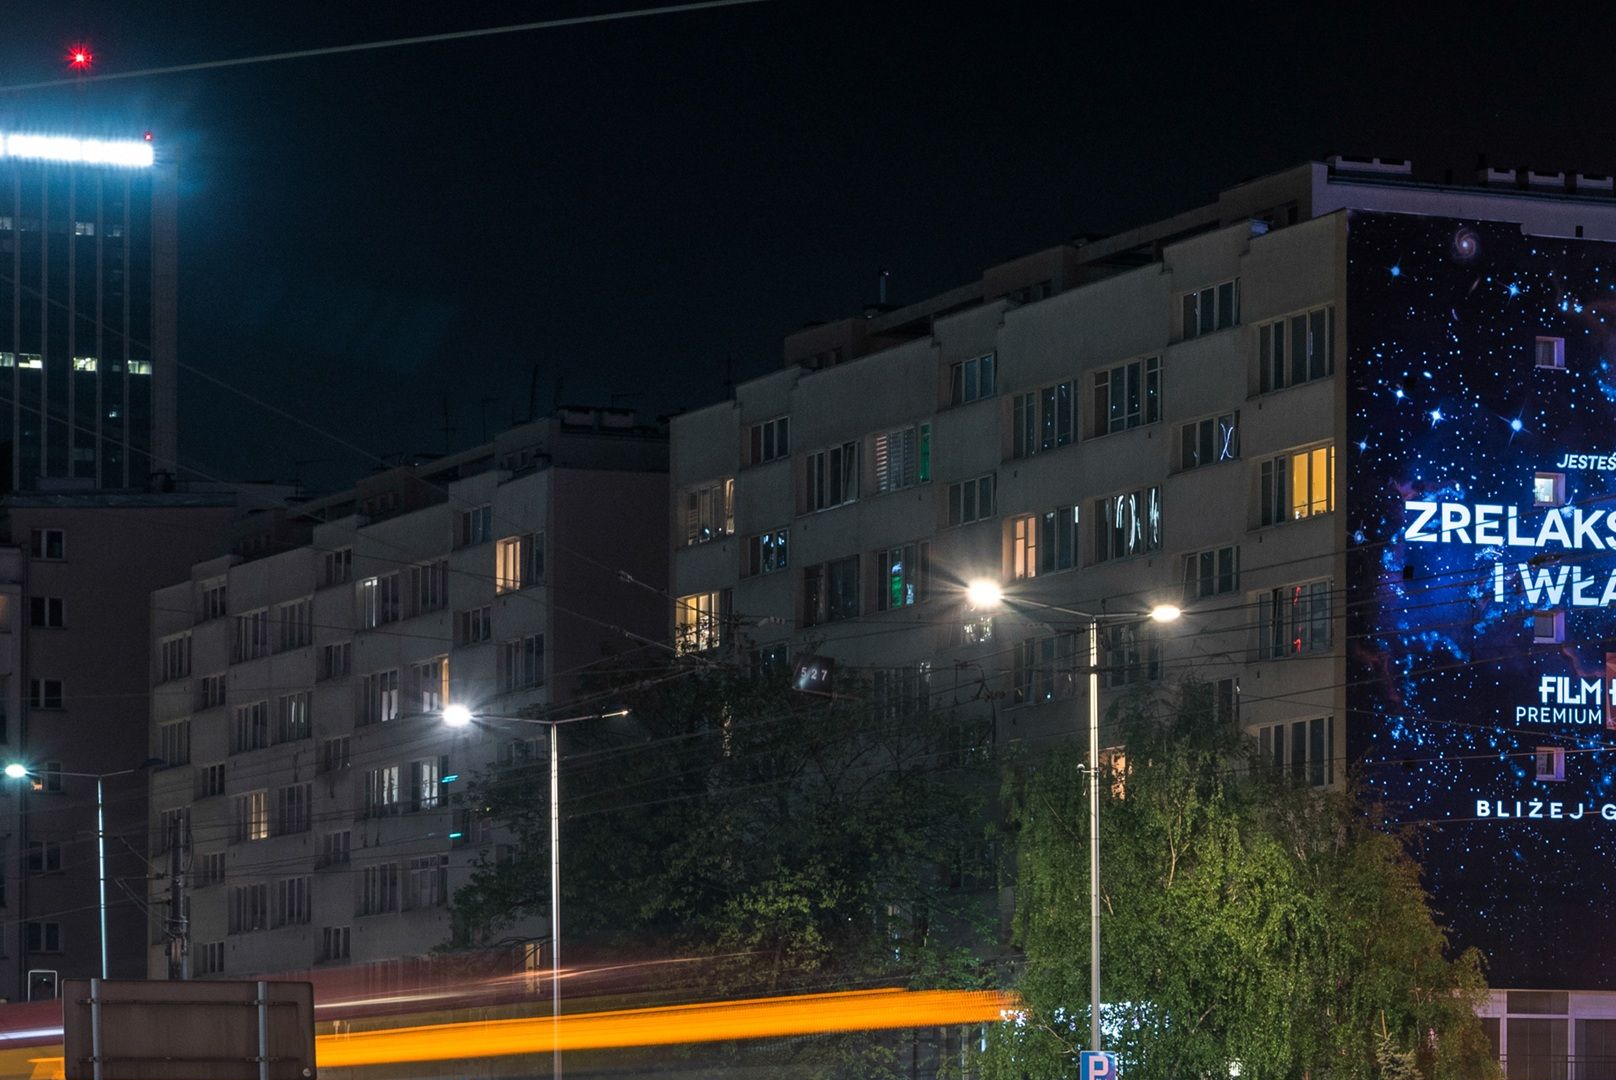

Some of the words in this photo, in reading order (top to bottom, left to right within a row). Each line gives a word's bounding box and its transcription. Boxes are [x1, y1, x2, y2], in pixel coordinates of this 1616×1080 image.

[1494, 562, 1504, 602] I
[1538, 676, 1602, 705] FILM
[1516, 706, 1602, 725] PREMIUM
[1476, 797, 1584, 820] BLIŻEJ
